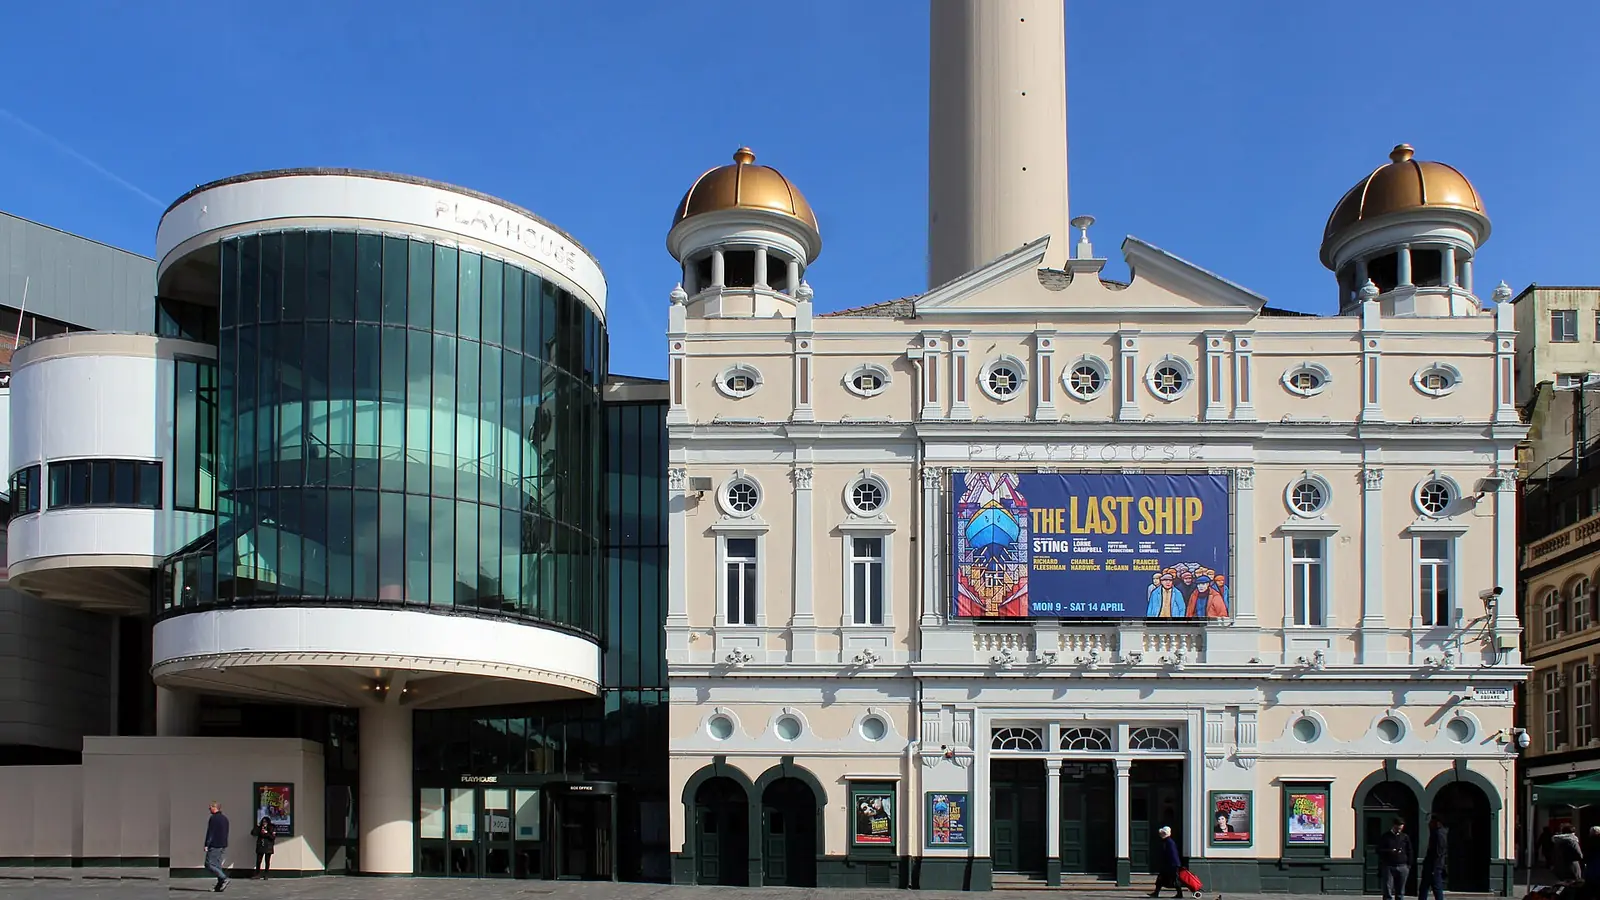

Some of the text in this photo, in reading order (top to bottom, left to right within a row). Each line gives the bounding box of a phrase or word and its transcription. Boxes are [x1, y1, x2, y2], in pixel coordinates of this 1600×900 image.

[435, 200, 576, 272] PLAYHOUSE
[966, 442, 1206, 464] PLAYHOUSE
[1030, 496, 1203, 535] THE LAST SHIP
[1033, 540, 1069, 553] STING
[1033, 602, 1053, 612] MON
[1055, 602, 1062, 612] 9
[1070, 602, 1085, 612] SAT
[1087, 602, 1098, 612] 14
[1100, 602, 1125, 612] APRIL
